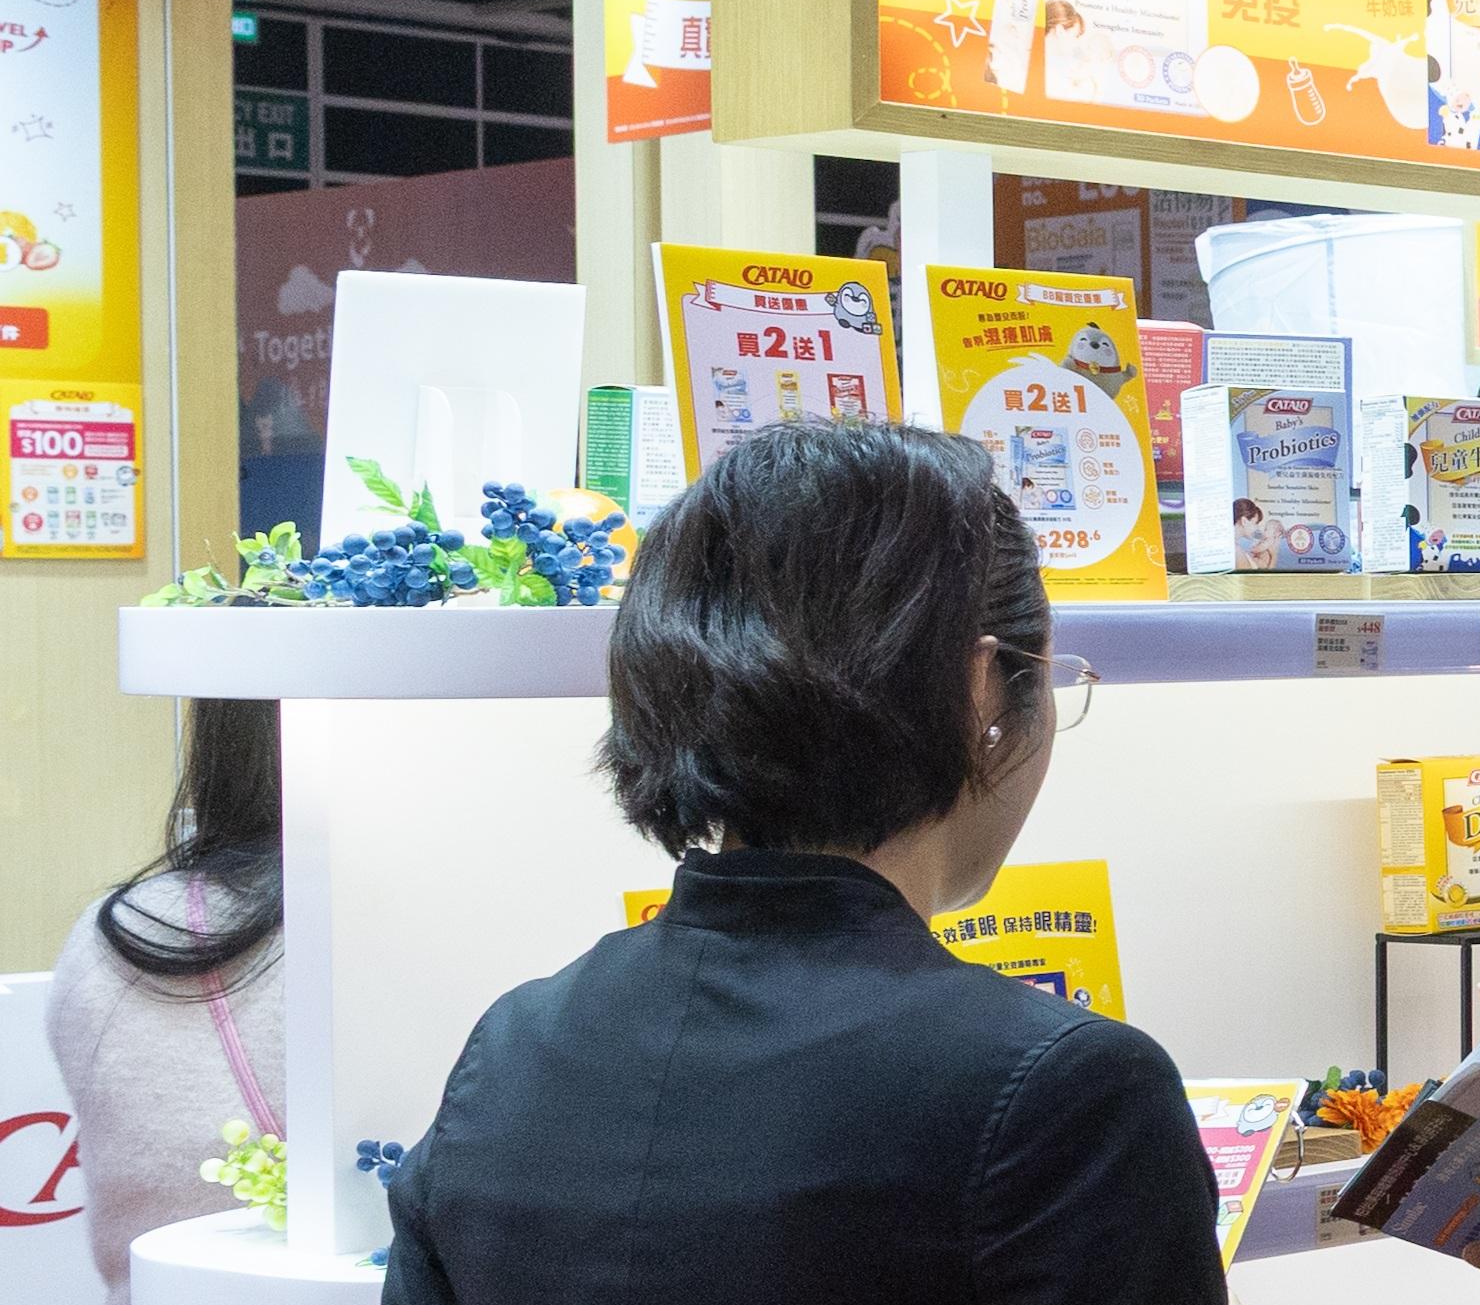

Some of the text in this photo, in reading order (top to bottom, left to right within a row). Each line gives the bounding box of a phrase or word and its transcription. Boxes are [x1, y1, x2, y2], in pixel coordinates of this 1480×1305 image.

[1366, 0, 1414, 18] 牛奶味
[257, 104, 296, 127] EXIT
[742, 265, 813, 289] CATALO
[940, 278, 1008, 301] CATALO
[754, 294, 809, 311] 買送優惠
[737, 326, 834, 361] 買2送1
[1004, 383, 1089, 414] 買2送1
[1267, 399, 1309, 412] CATALO
[1275, 417, 1304, 431] Baby's
[21, 429, 84, 458] $100
[1249, 432, 1337, 465] Probiotics
